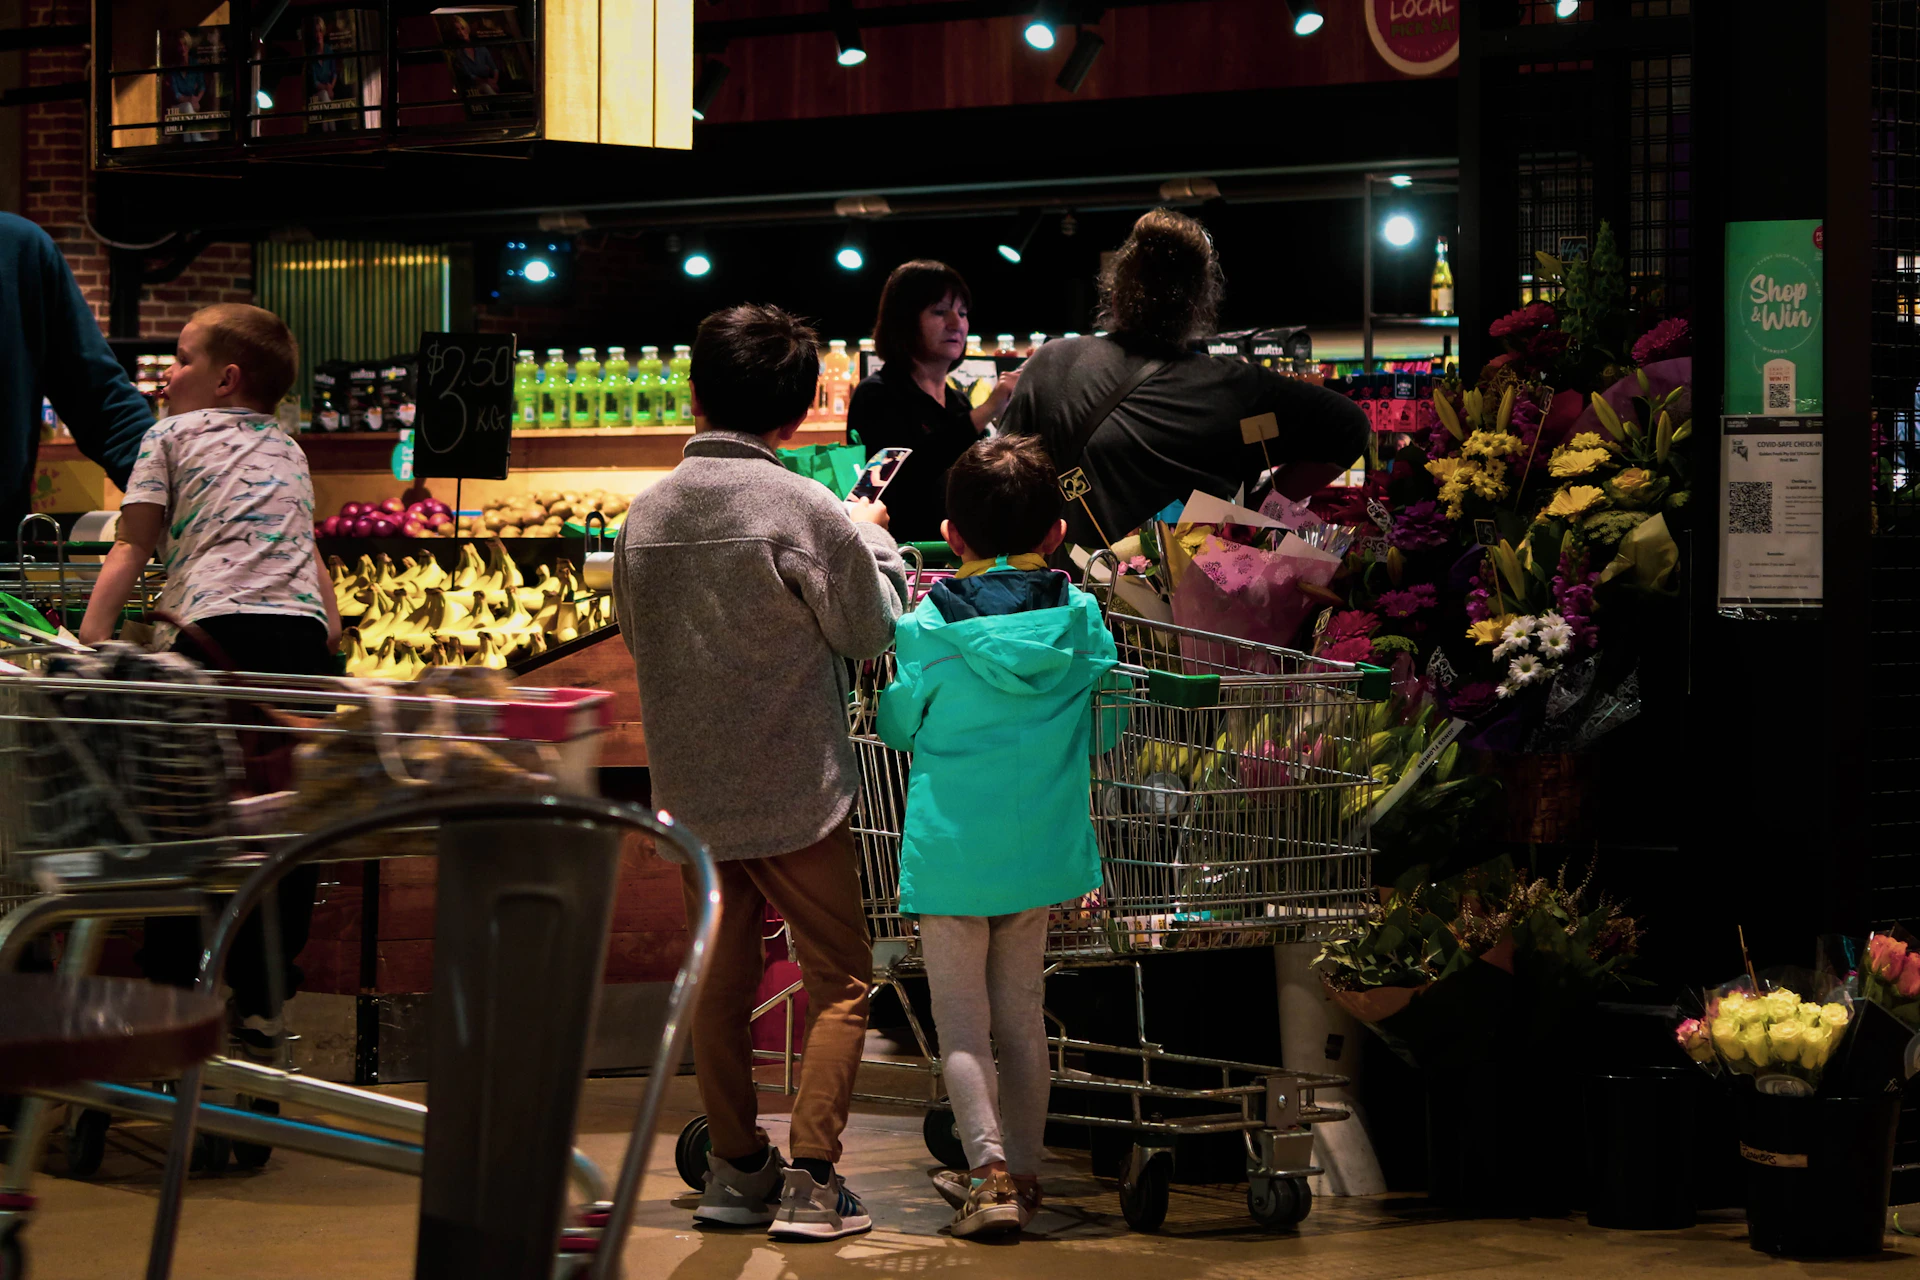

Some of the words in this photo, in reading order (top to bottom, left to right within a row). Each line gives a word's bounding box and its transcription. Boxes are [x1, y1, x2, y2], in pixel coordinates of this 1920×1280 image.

[1390, 0, 1455, 21] LOCAL
[1391, 22, 1424, 37] PICK
[1750, 273, 1808, 309] Shop
[1750, 305, 1761, 322] &
[1762, 302, 1812, 331] Win
[475, 404, 506, 432] KG
[1437, 727, 1455, 746] JONGS
[1417, 744, 1440, 769] FLOWERS
